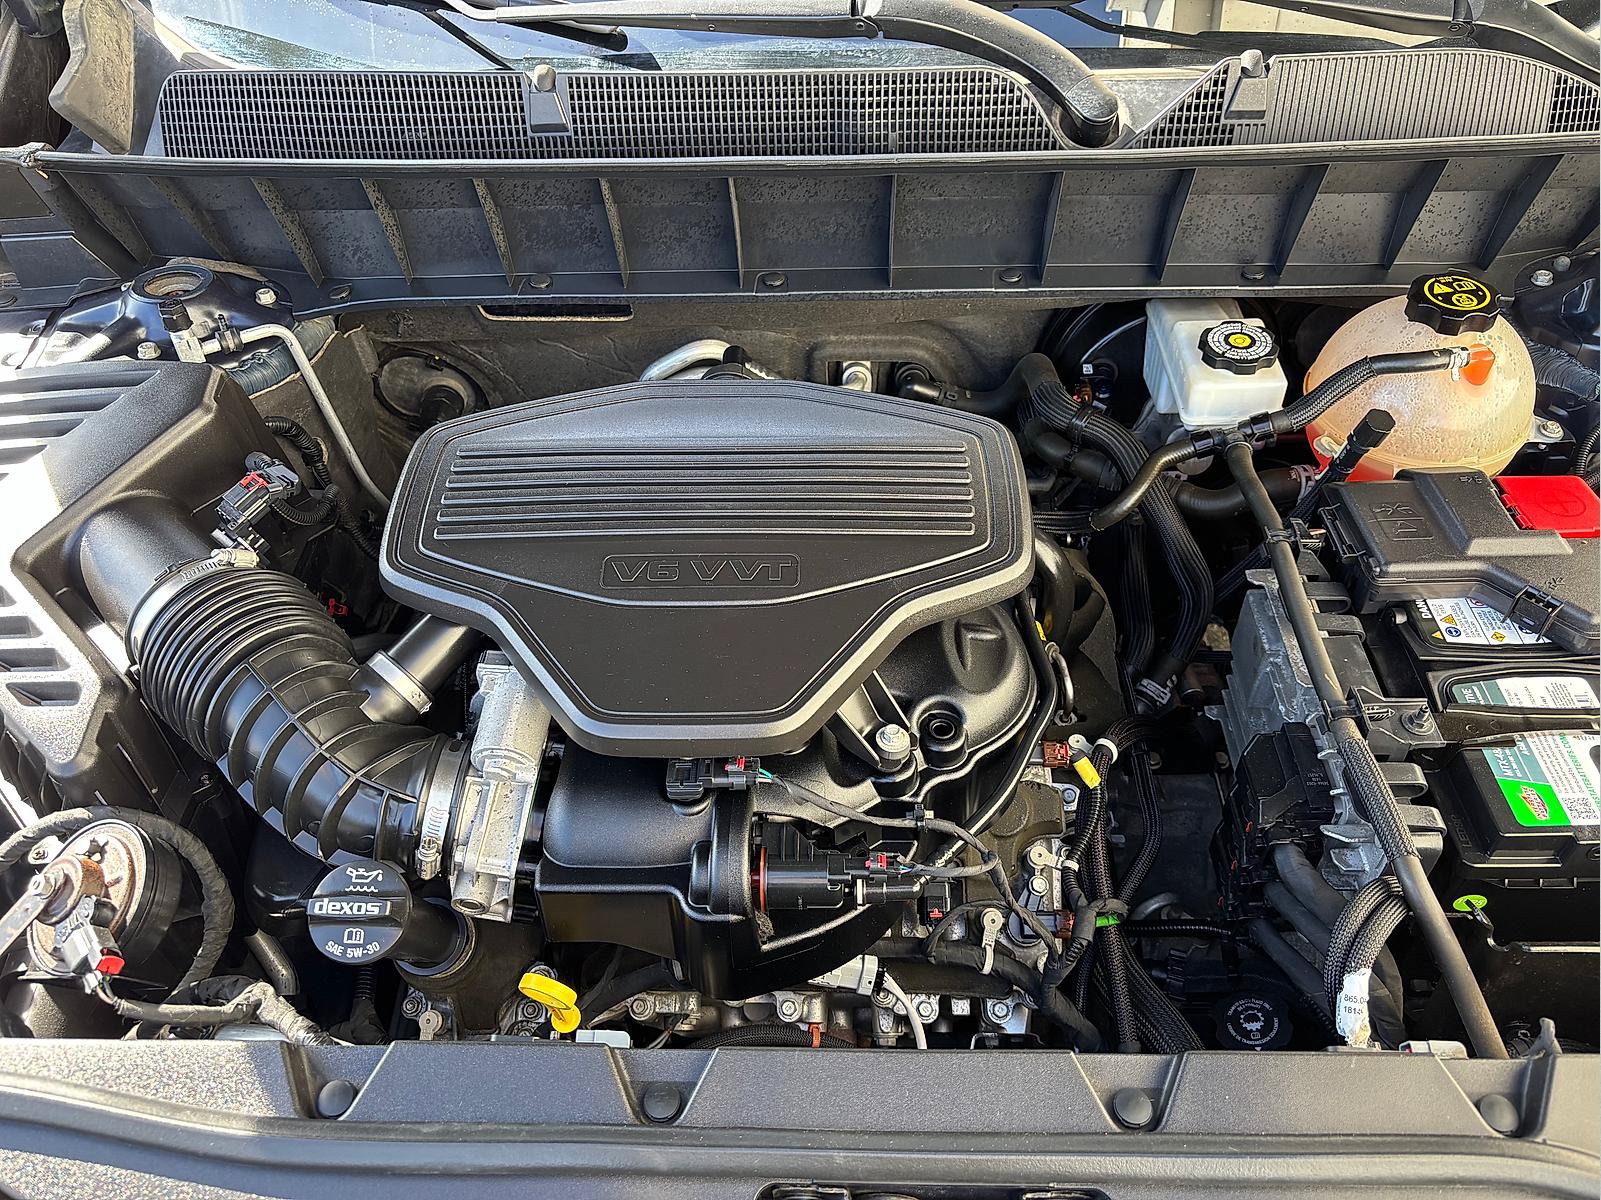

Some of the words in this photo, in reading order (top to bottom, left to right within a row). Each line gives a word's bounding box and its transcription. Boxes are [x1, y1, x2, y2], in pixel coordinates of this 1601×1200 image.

[611, 560, 679, 582] V6
[690, 560, 792, 581] VVT
[325, 940, 345, 957] SAE
[346, 941, 381, 958] 5W-30
